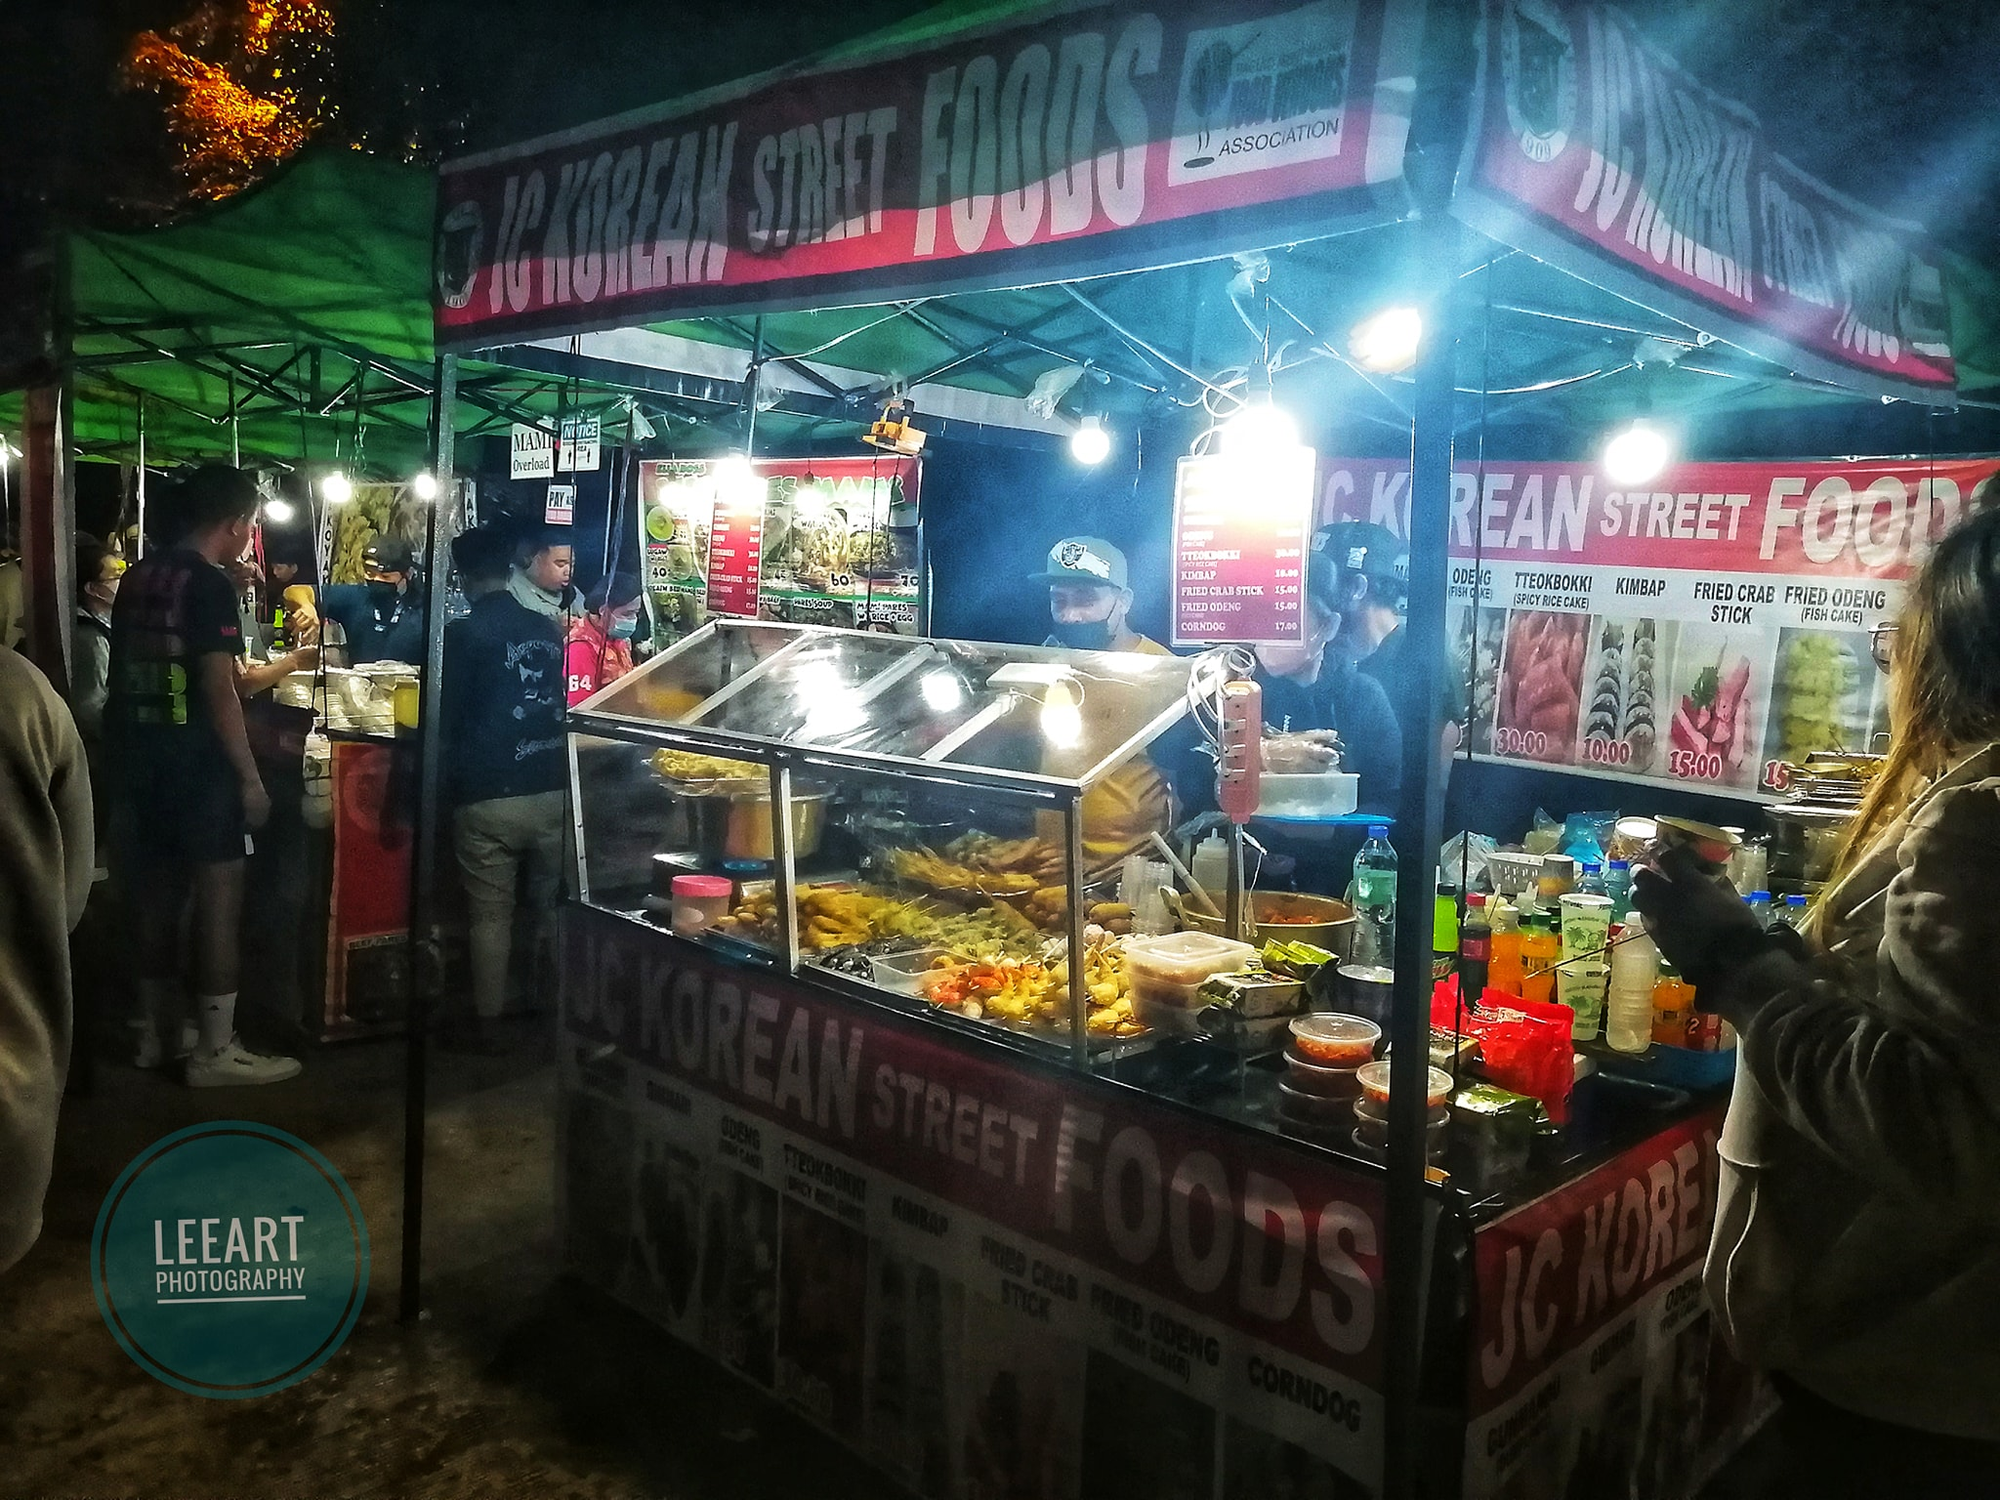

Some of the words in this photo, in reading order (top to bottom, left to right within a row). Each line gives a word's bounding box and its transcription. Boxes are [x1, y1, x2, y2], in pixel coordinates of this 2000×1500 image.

[1218, 117, 1339, 157] ASSOCIATION
[542, 121, 739, 303] KOREAN
[748, 106, 898, 254] STREET
[914, 13, 1163, 257] FOODS
[514, 431, 553, 452] MAMI
[513, 456, 550, 472] Overload
[548, 491, 565, 508] PAY
[1368, 471, 1594, 552] KREAN
[1600, 492, 1751, 541] STREET
[1758, 474, 1986, 566] FOOD
[1181, 571, 1217, 580] KIMBAP
[1514, 571, 1593, 593] TTEOKBOKKI
[1181, 586, 1208, 596] FRIED
[1209, 586, 1235, 596] CRAB
[1235, 586, 1264, 596] STICK
[1275, 585, 1298, 595] 15.00
[1615, 577, 1666, 597] KIMBAP
[1693, 582, 1733, 602] FRIED
[1737, 584, 1776, 604] CRAB
[1784, 585, 1828, 605] FRIED
[1832, 588, 1887, 610] ODENG
[1181, 602, 1208, 612] FRIED
[1209, 602, 1242, 612] ODENG
[1275, 602, 1298, 611] 15.00
[1513, 593, 1540, 606] (SPICY
[1542, 594, 1562, 607] RICE
[1563, 595, 1590, 611] CAKE)
[1711, 604, 1752, 624] STICK
[1801, 608, 1828, 623] (FISH
[1830, 609, 1863, 626] CAKE)
[1181, 622, 1226, 631] CORNDOG
[1275, 622, 1298, 631] 17.00
[1496, 728, 1547, 756] 30.00
[1582, 737, 1631, 765] 10.00
[1669, 750, 1723, 780] 15.00
[1763, 760, 1791, 791] 15
[640, 955, 864, 1140] KOREAN
[873, 1062, 1038, 1186] STREET
[1055, 1102, 1378, 1355] FOODS
[1481, 1227, 1563, 1390] JC
[1248, 1356, 1361, 1432] CORNDOG
